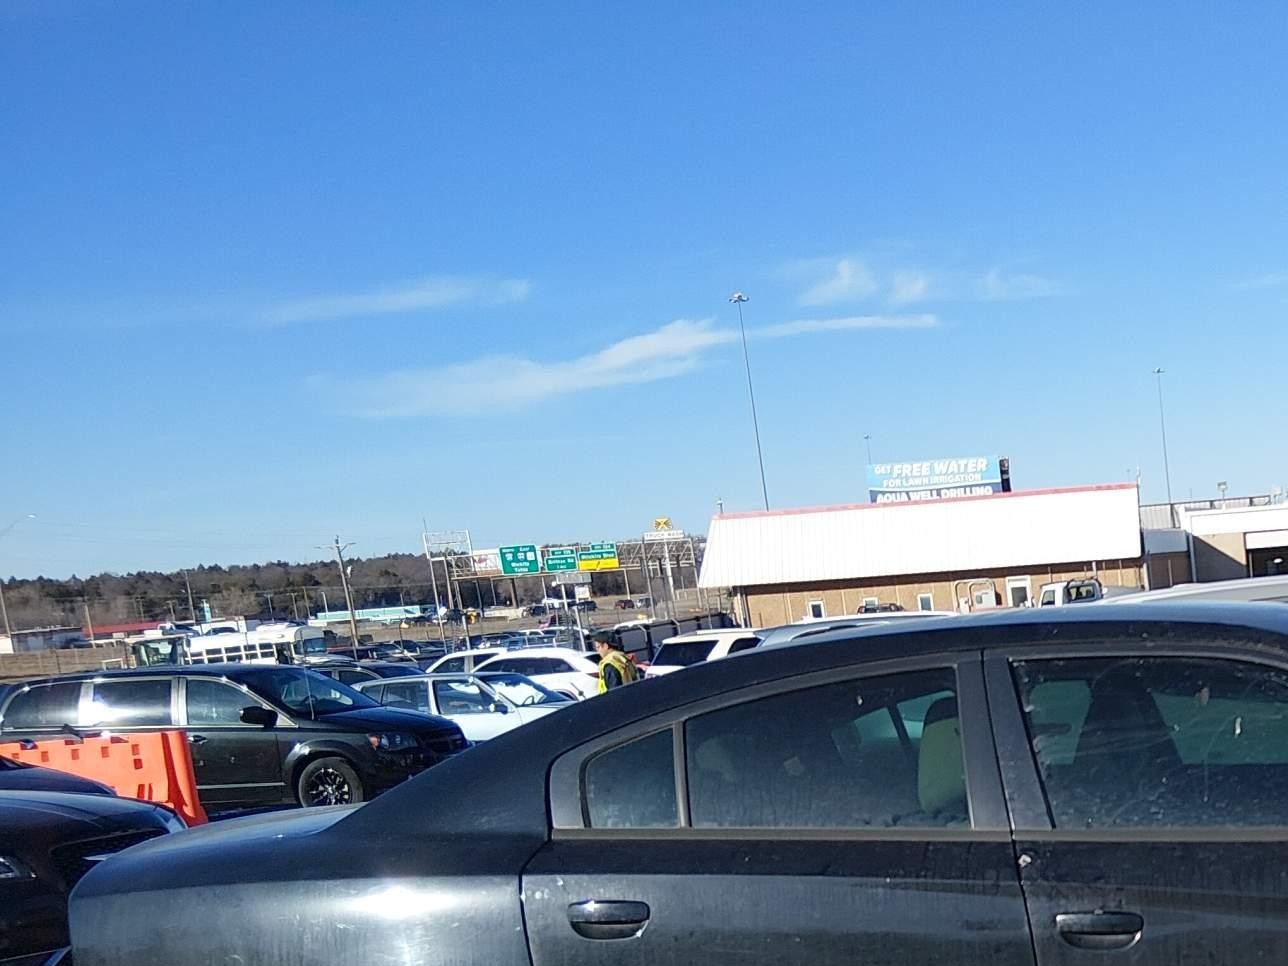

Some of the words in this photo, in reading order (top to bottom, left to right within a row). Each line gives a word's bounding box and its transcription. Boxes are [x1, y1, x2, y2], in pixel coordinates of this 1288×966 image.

[893, 461, 931, 478] FREE
[934, 457, 987, 475] WATER
[883, 478, 902, 489] FOR
[903, 476, 929, 488] LAWN
[930, 473, 982, 486] IRRIGATION
[876, 490, 908, 504] AQUA
[909, 489, 940, 501] WELL
[941, 485, 993, 500] DRILLING
